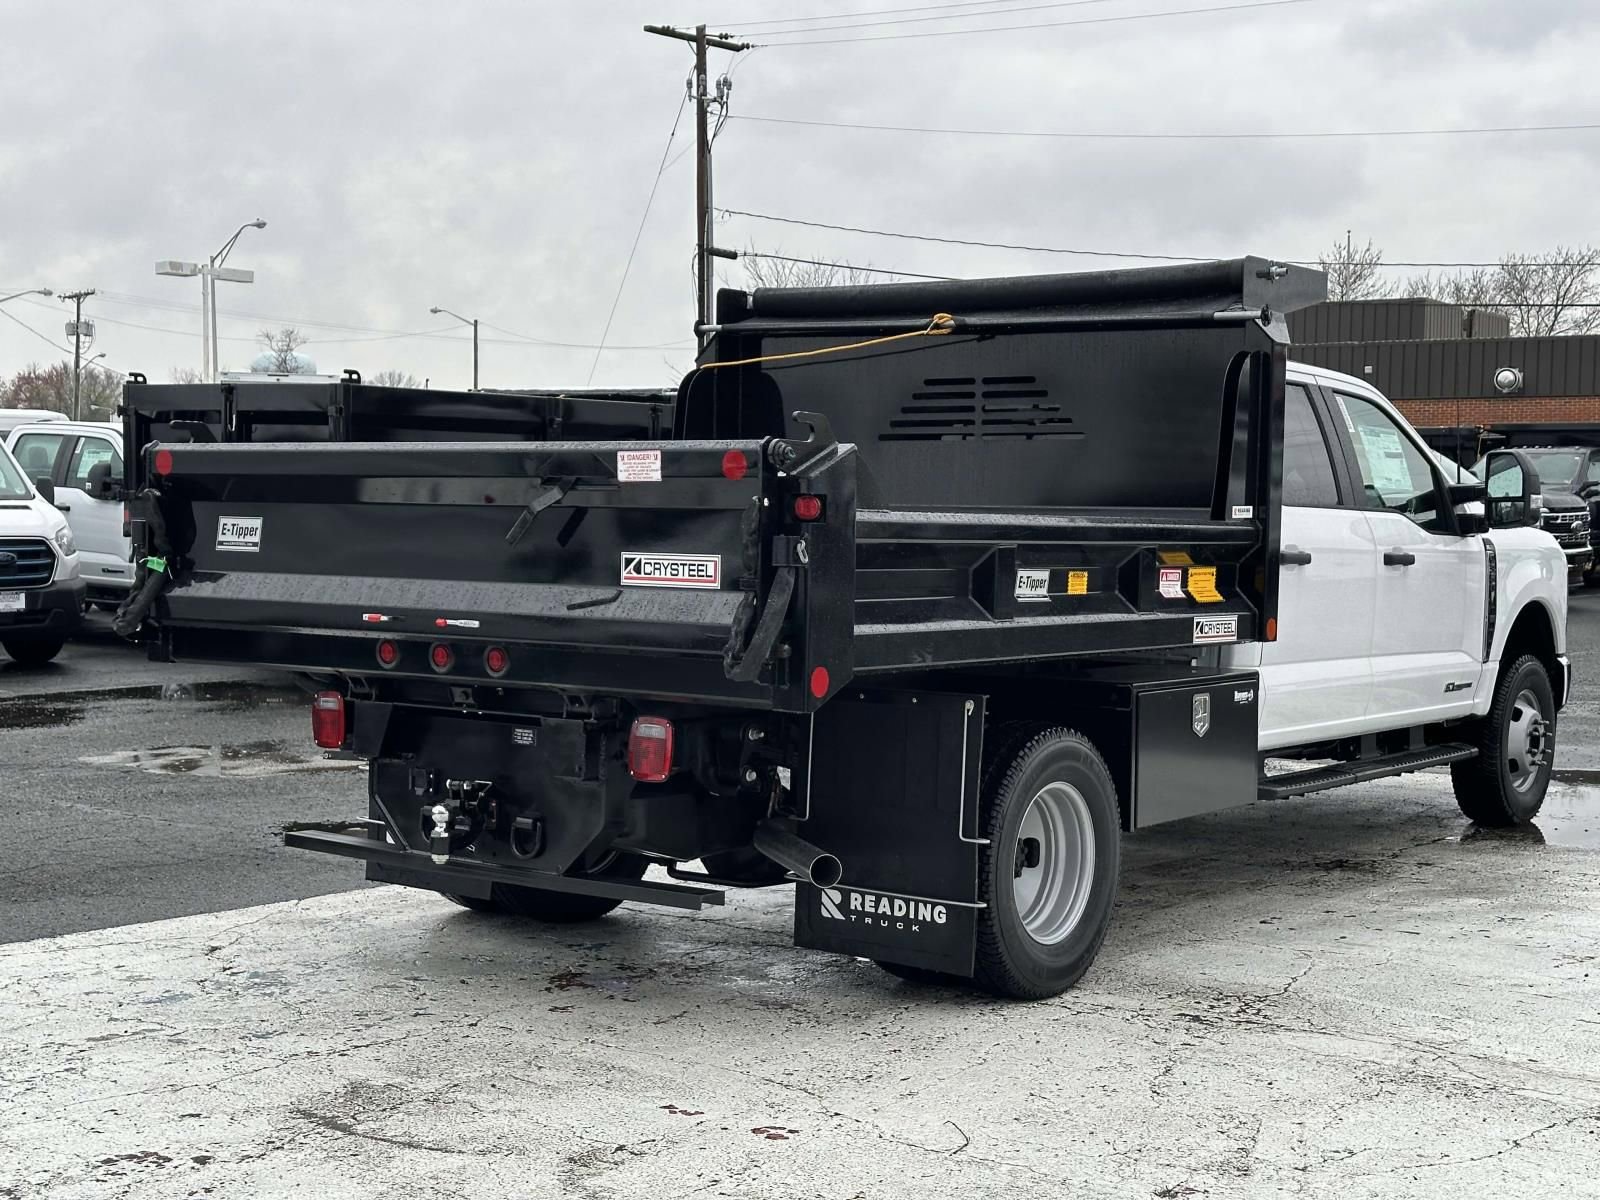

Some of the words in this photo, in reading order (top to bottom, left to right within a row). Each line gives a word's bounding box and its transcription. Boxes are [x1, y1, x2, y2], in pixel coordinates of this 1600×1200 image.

[221, 523, 258, 539] E-Tipper
[643, 561, 713, 578] CRYSTEEL
[1018, 576, 1047, 591] E-Tipper
[1204, 622, 1234, 635] CRYSTEEL
[850, 892, 947, 924] READING
[850, 915, 920, 932] TRUCK
